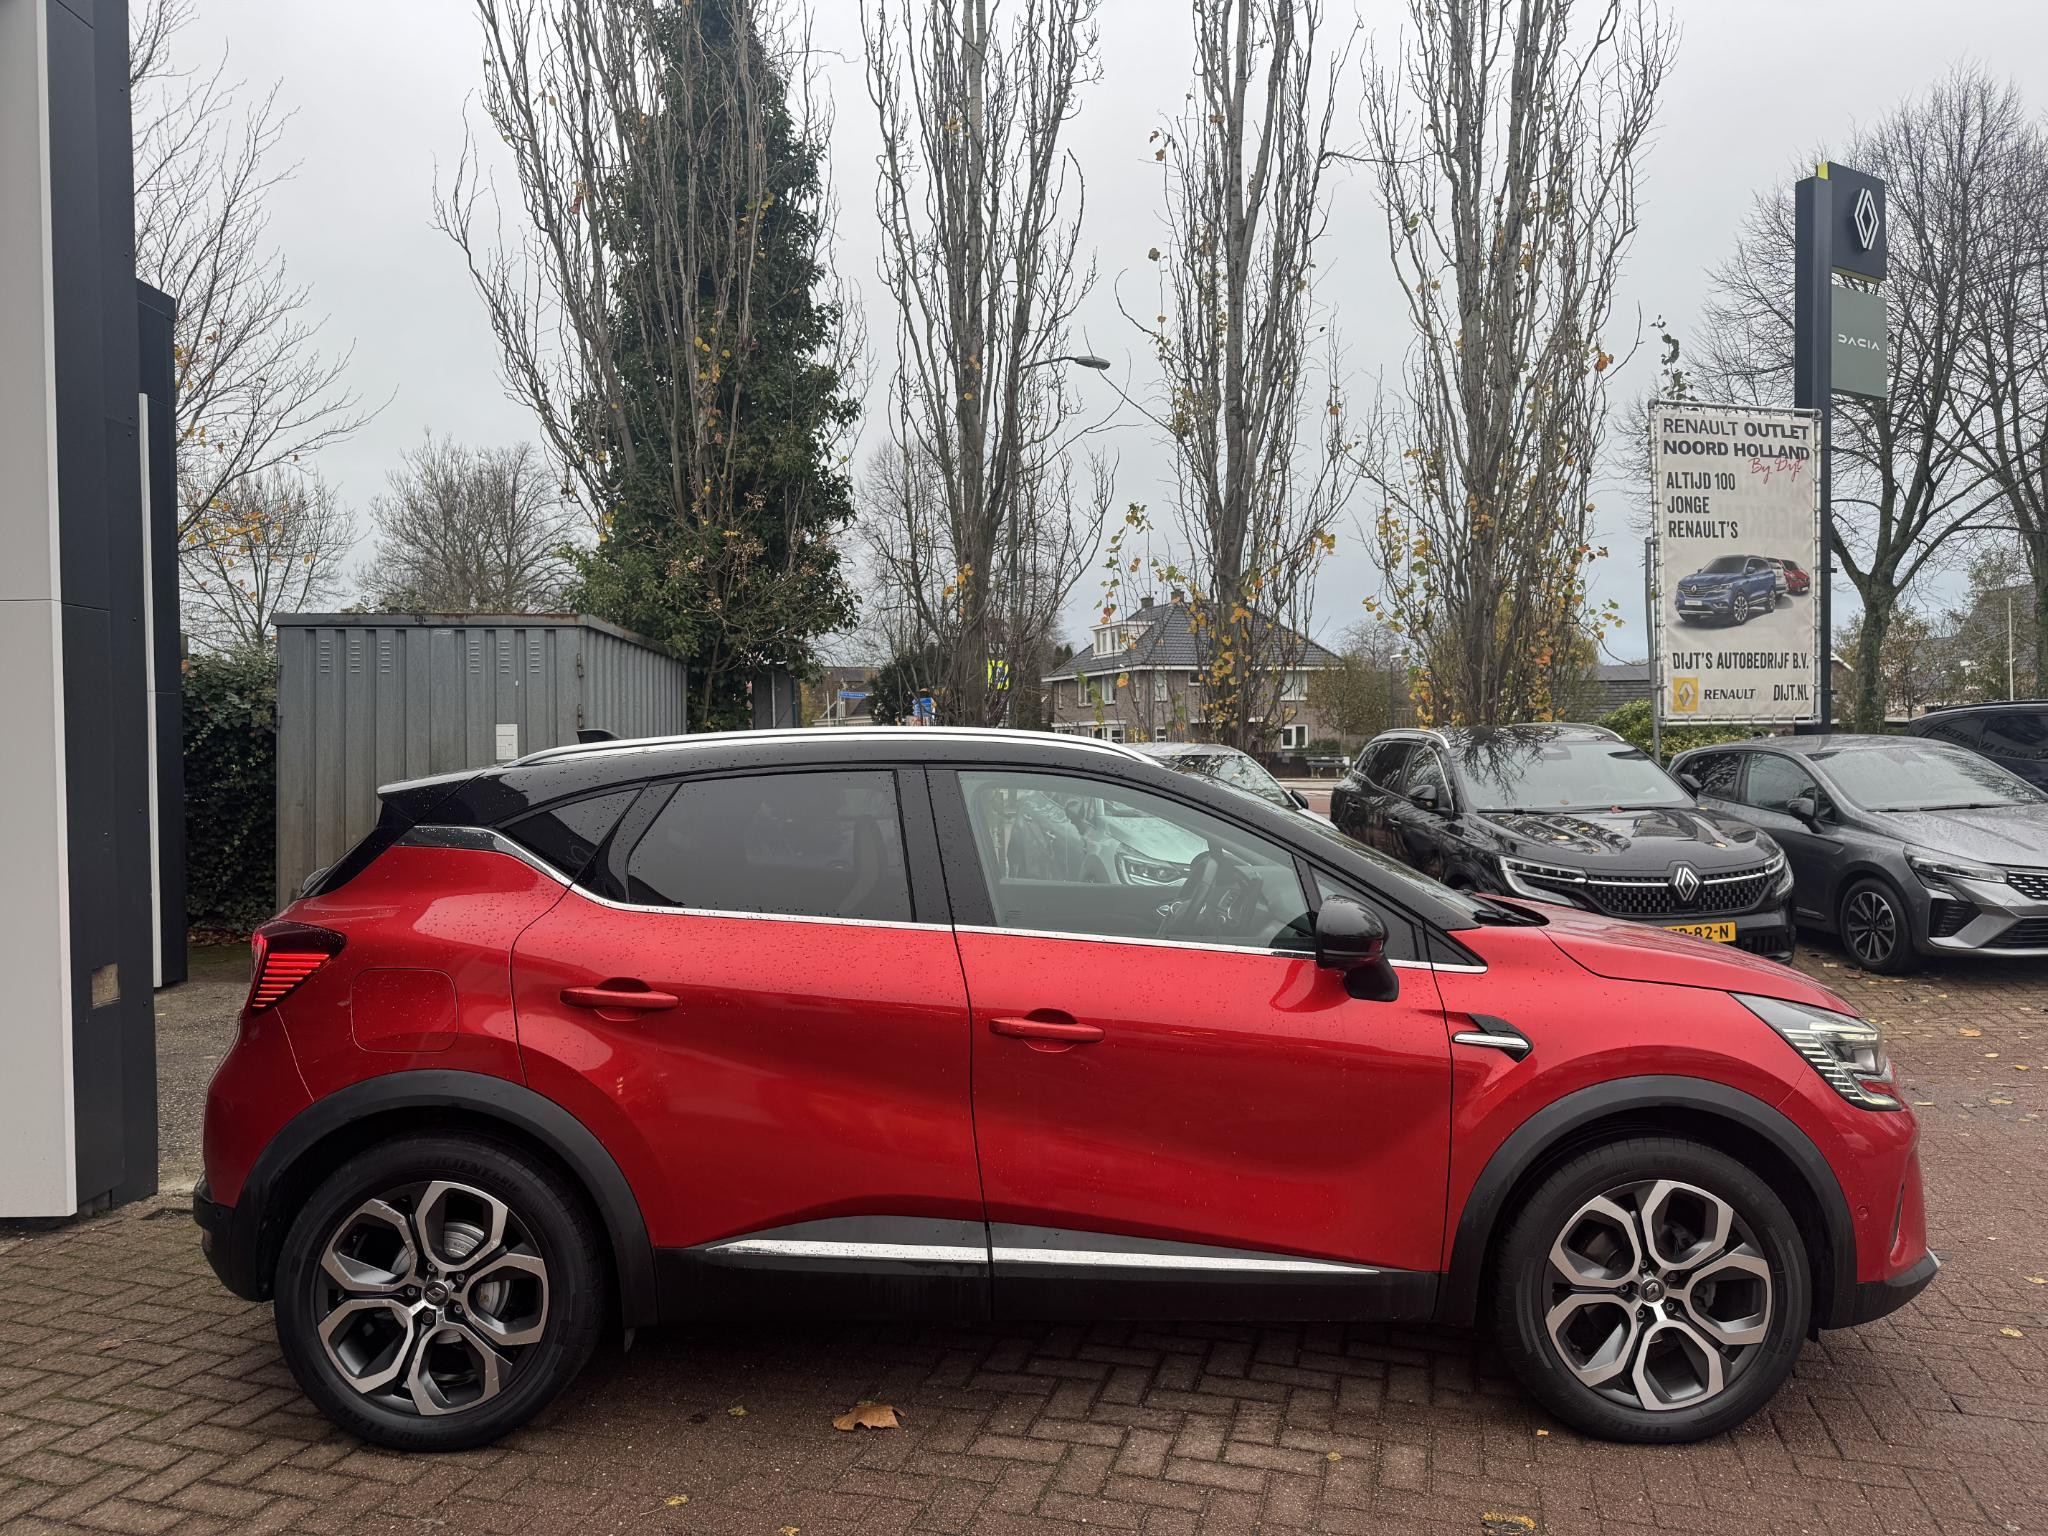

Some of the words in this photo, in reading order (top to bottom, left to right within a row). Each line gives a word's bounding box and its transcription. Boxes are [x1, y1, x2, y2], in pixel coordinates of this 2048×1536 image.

[1837, 333, 1880, 351] DACIA
[1663, 418, 1738, 436] RENAULT
[1744, 422, 1809, 440] OUTLET
[1663, 440, 1729, 456] NOORD
[1734, 443, 1810, 460] HOLLAND
[1749, 457, 1771, 484] By
[1666, 472, 1711, 490] ALTIJD
[1714, 472, 1736, 491] 100
[1667, 495, 1710, 514] JONGE
[1668, 520, 1738, 539] RENAULT'S
[1672, 652, 1713, 669] DIJT'S
[1716, 652, 1790, 669] AUTOBEDRIJF
[1792, 652, 1809, 669] B.V.
[1704, 688, 1756, 700] RENAULT
[1773, 684, 1809, 701] DIJT.NL
